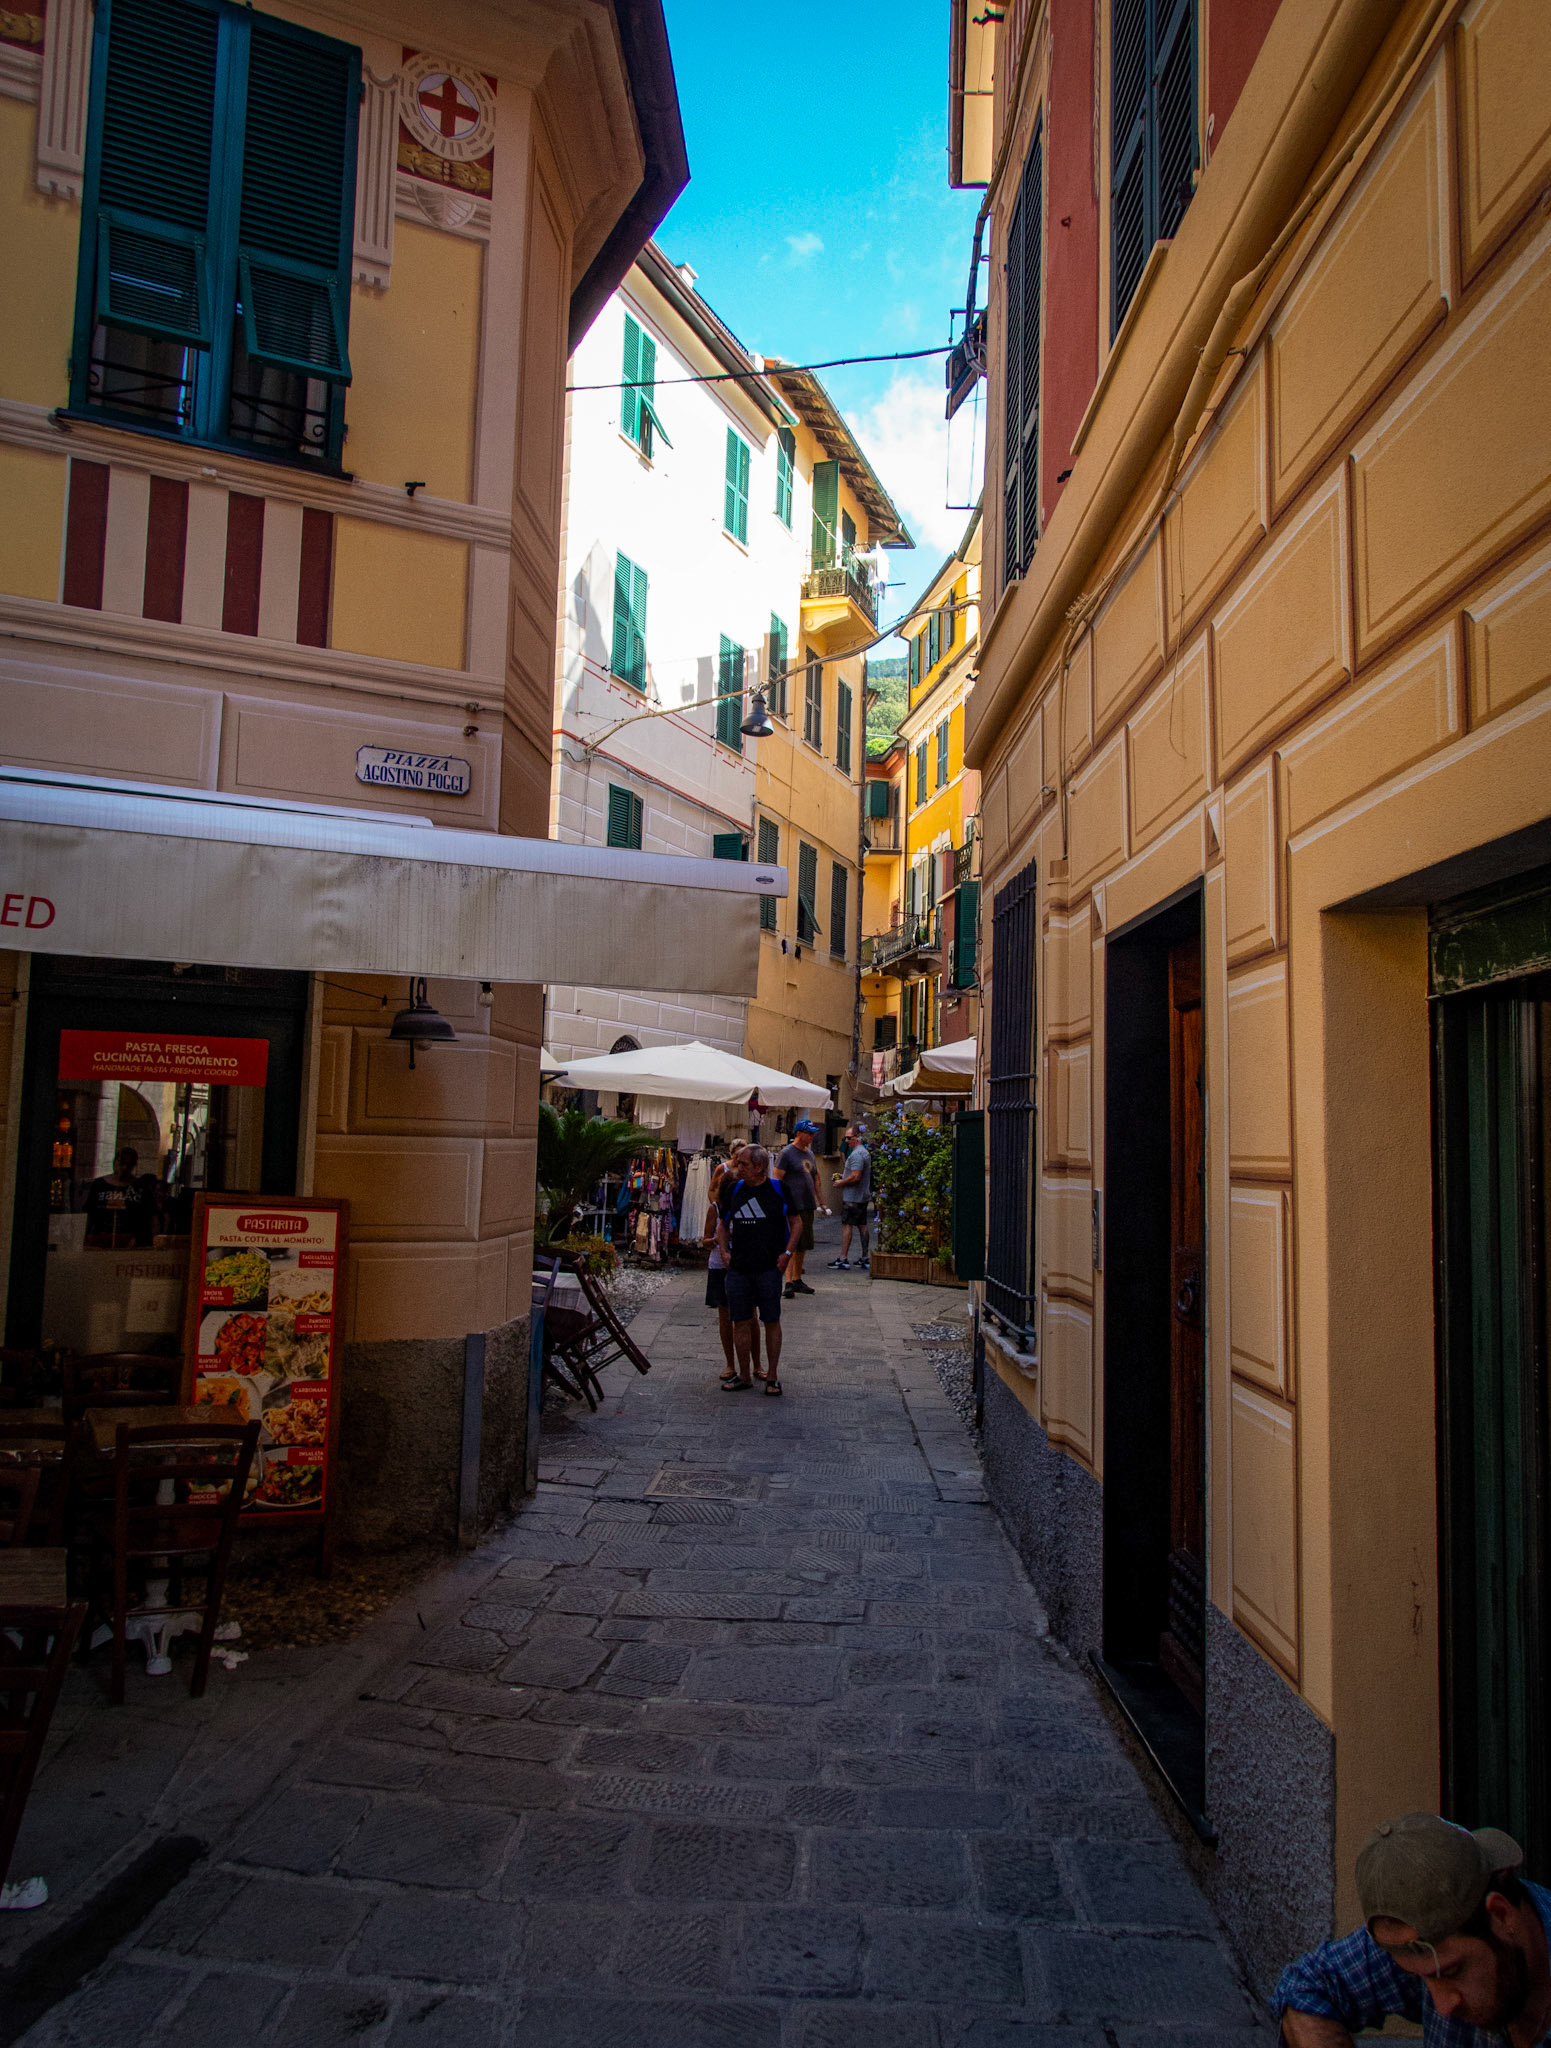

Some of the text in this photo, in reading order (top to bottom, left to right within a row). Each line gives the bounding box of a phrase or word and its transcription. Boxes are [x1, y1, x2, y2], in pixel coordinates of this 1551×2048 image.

[383, 752, 449, 771] PIAZZA
[363, 764, 464, 792] AGOSTINO POGGI
[0, 893, 56, 929] ED
[125, 1042, 209, 1055] PASTA FRESCA
[93, 1052, 238, 1067] CUCINATA AL MOMENTO
[92, 1064, 239, 1077] HANDMADE PASTA FRESHLY COOKED
[244, 1218, 302, 1231] PASTARITA
[219, 1235, 242, 1243] PASTA
[284, 1237, 325, 1245] MOMENTO!
